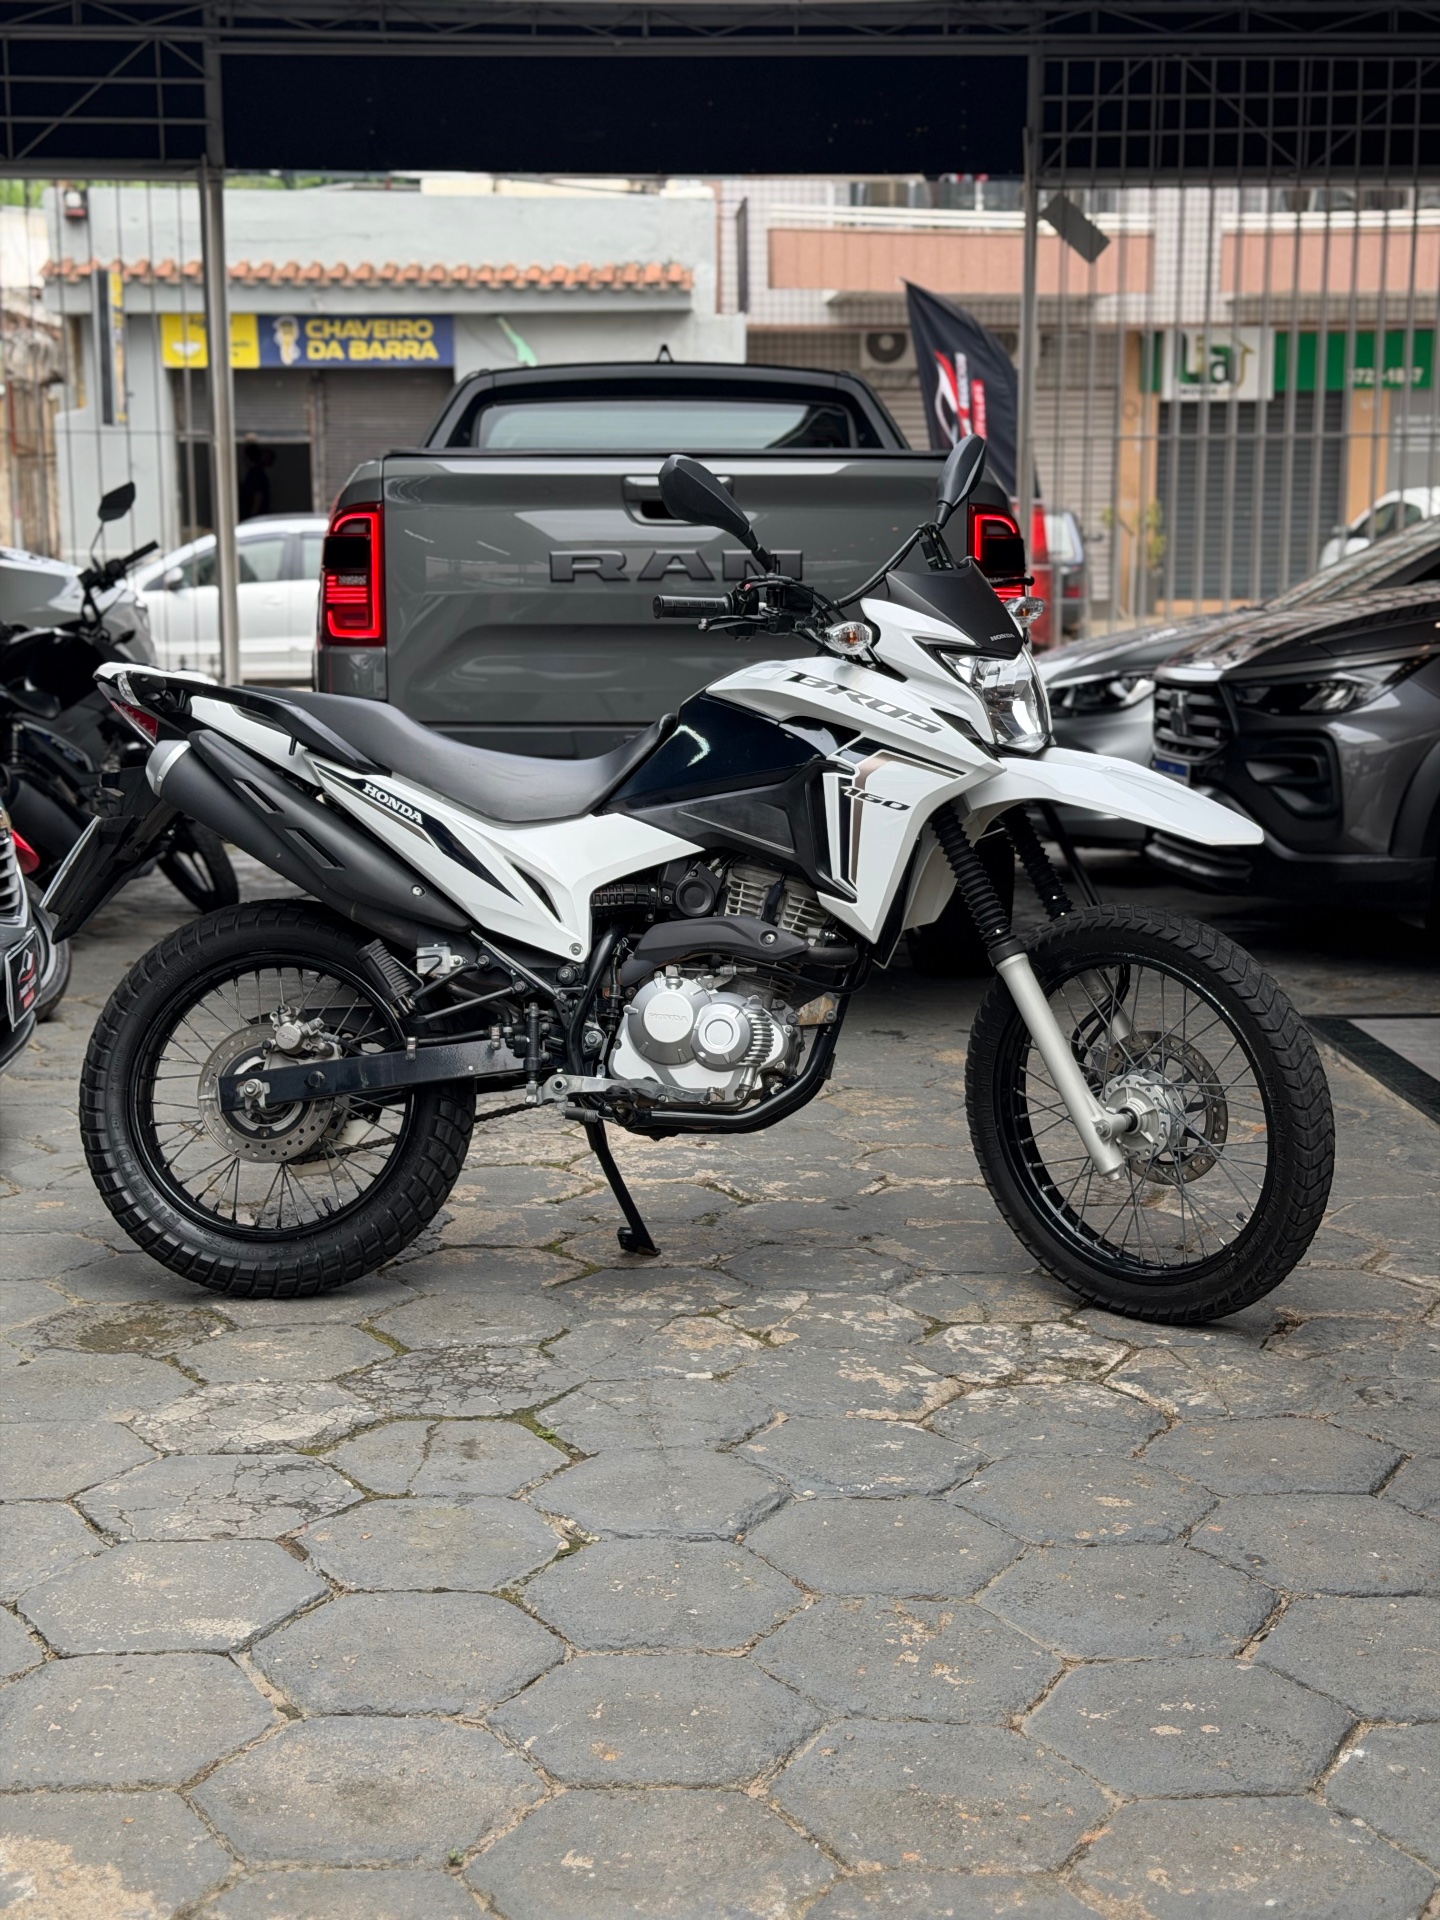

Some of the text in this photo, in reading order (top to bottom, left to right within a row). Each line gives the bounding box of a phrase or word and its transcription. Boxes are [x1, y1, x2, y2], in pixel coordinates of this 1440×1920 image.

[305, 319, 434, 339] CHAVEIRO
[306, 340, 440, 360] DA BARRA
[549, 550, 803, 582] RAM
[989, 633, 1016, 642] HONDA
[783, 671, 946, 734] BROS
[362, 782, 423, 825] HONDA
[841, 786, 911, 811] 160
